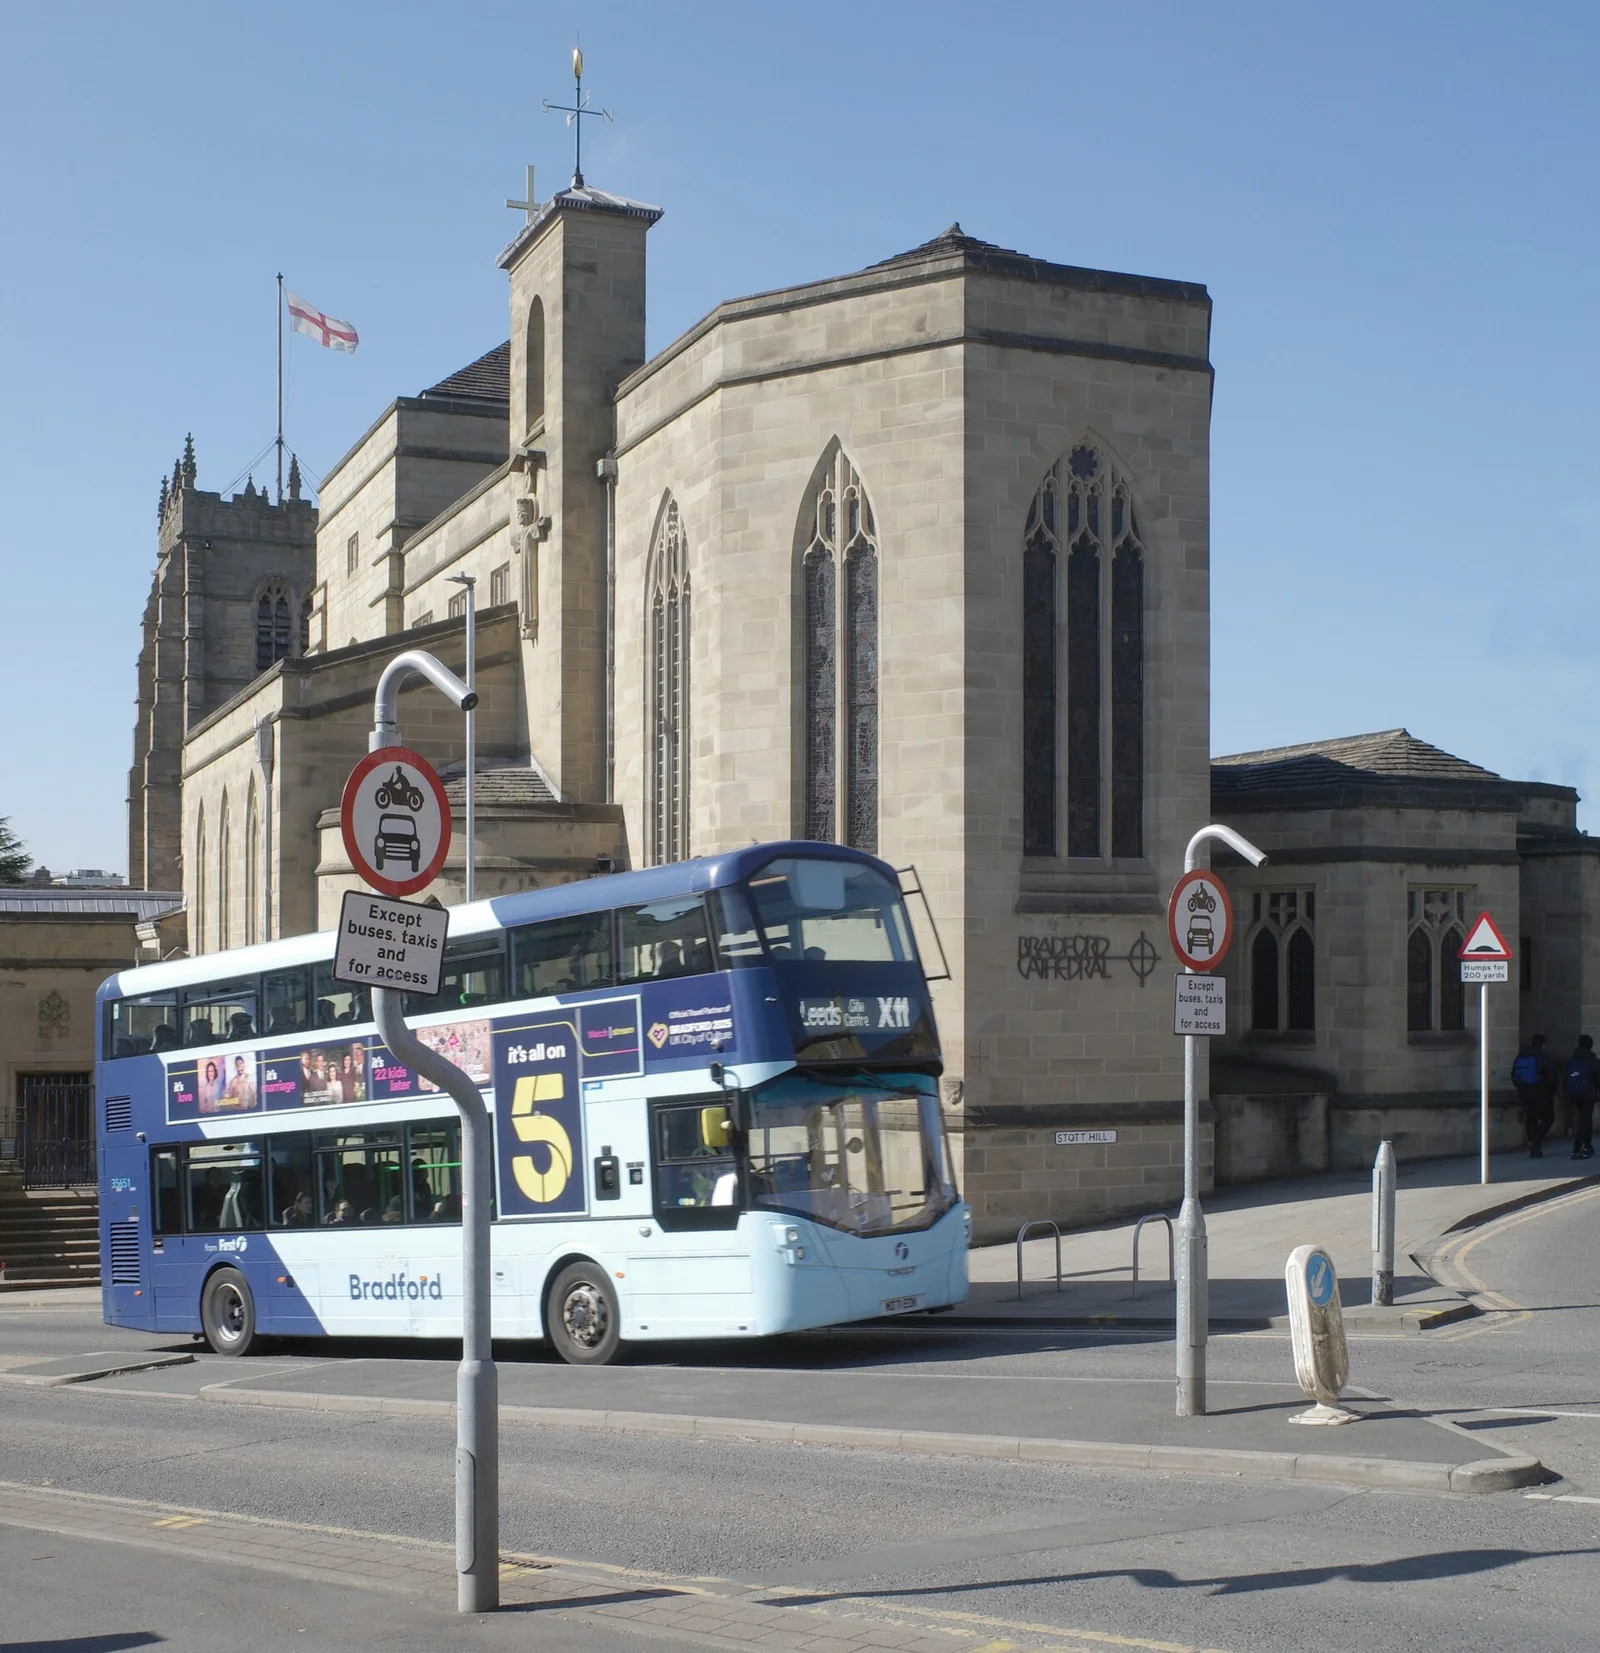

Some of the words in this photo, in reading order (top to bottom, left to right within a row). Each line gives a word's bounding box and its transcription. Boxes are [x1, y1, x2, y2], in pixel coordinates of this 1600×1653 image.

[369, 904, 422, 927] Except
[347, 919, 397, 942] buses,
[402, 930, 438, 949] taxis
[1018, 934, 1110, 959] BRADFORD
[377, 947, 406, 962] and
[348, 959, 371, 975] for
[377, 966, 428, 985] access
[1017, 956, 1112, 980] CATHEDRAL
[1464, 964, 1491, 972] Humps
[1188, 980, 1215, 992] Except
[1178, 992, 1203, 1003] buses,
[1205, 994, 1223, 1004] taxis
[800, 1000, 842, 1026] Leeds
[1194, 1006, 1209, 1016] and
[1181, 1018, 1192, 1028] for
[1195, 1020, 1221, 1029] access
[669, 1034, 681, 1046] UK
[681, 1033, 696, 1046] City
[507, 1044, 528, 1064] it's
[528, 1043, 546, 1061] all
[546, 1045, 566, 1059] on
[374, 1068, 387, 1081] 22
[388, 1066, 408, 1080] kids
[173, 1081, 185, 1093] it's
[177, 1092, 193, 1103] love
[511, 1073, 573, 1203] 5
[1057, 1132, 1086, 1143] STOTT
[1088, 1132, 1107, 1142] HILL
[218, 1238, 237, 1252] First
[349, 1272, 443, 1301] Bradford
